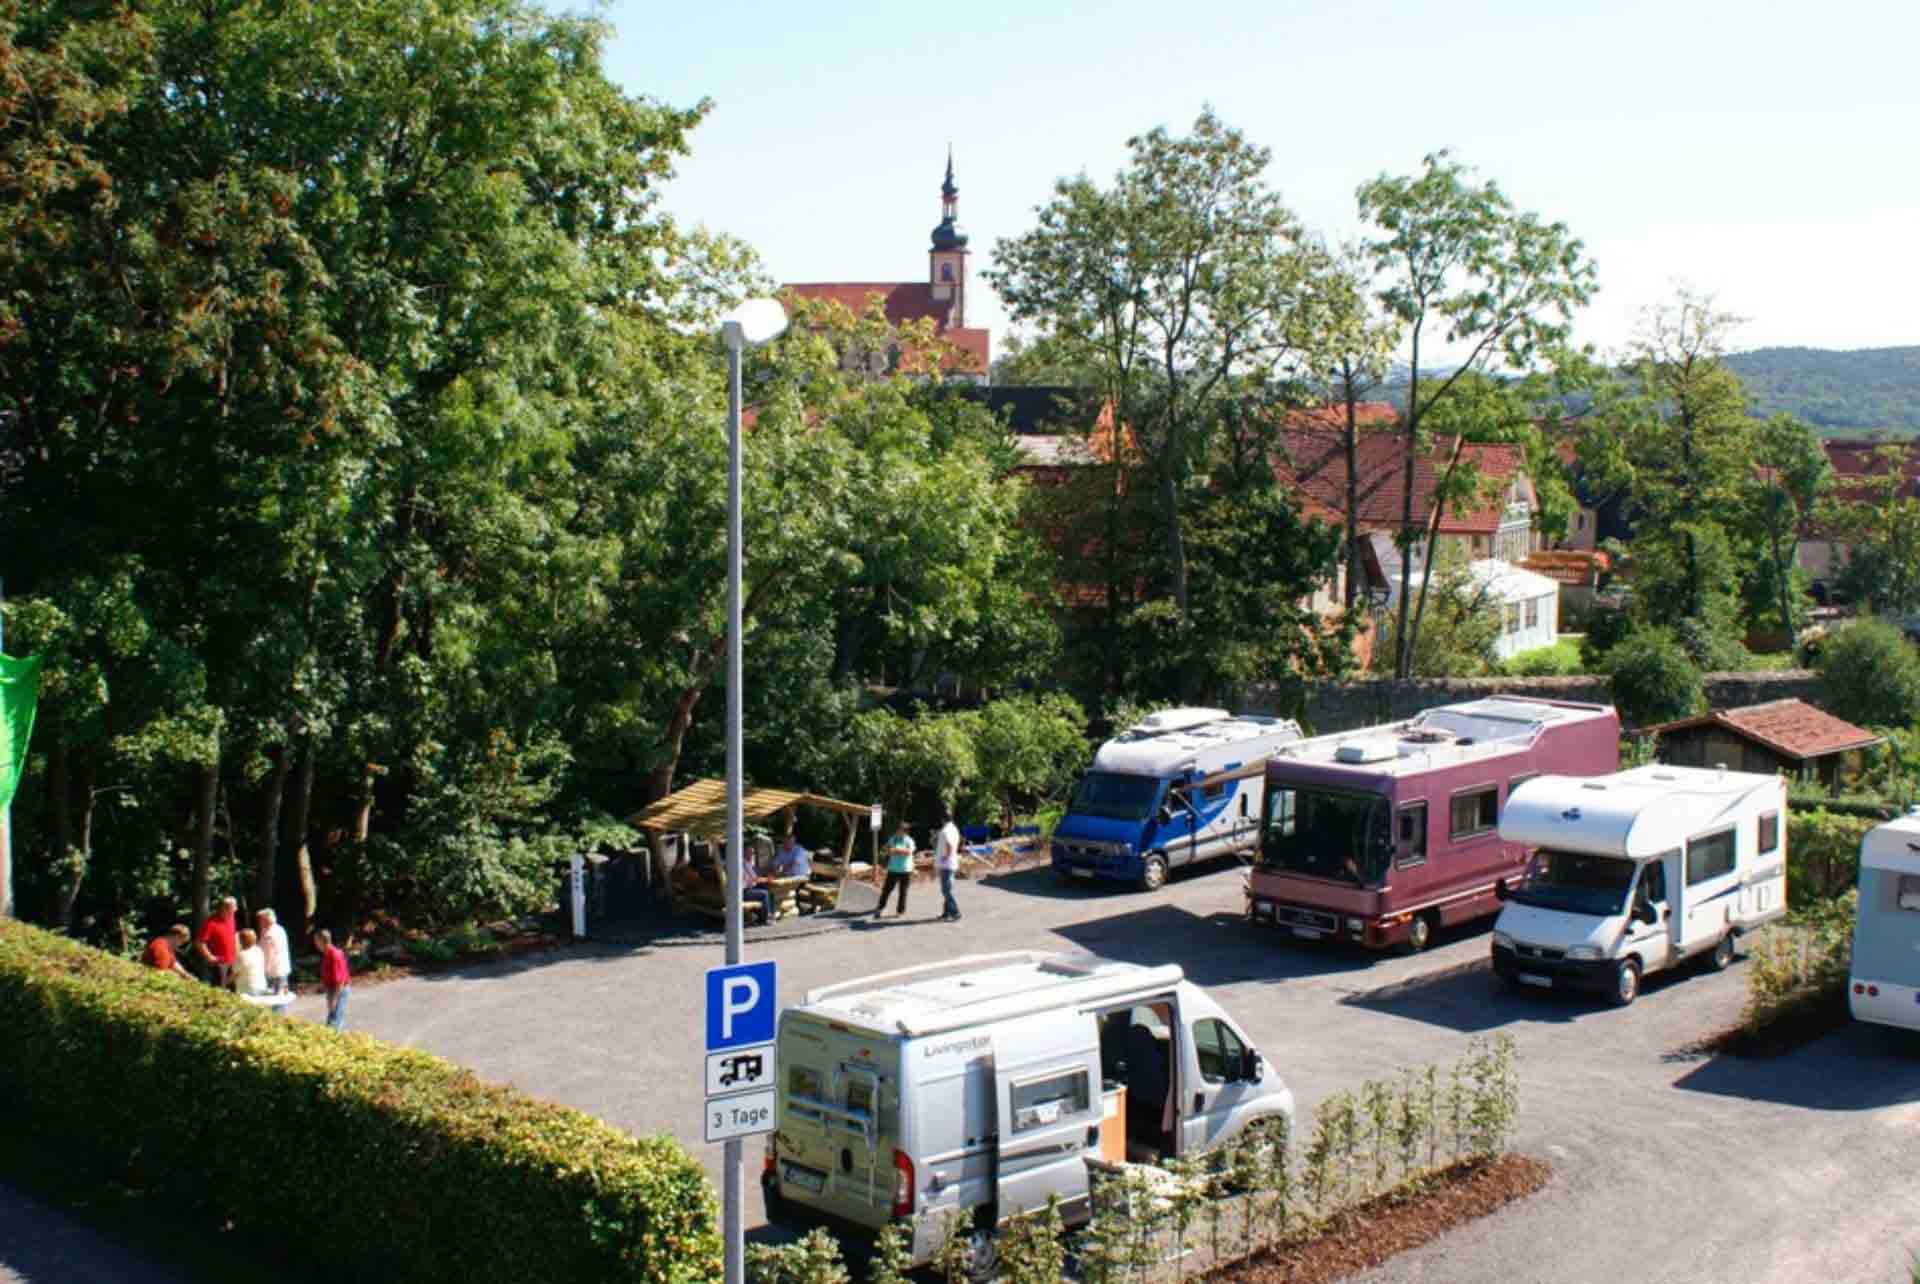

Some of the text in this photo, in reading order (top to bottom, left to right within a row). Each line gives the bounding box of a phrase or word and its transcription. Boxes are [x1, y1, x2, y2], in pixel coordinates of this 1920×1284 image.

[722, 976, 760, 1039] P
[713, 1107, 769, 1128] 3 Tage
